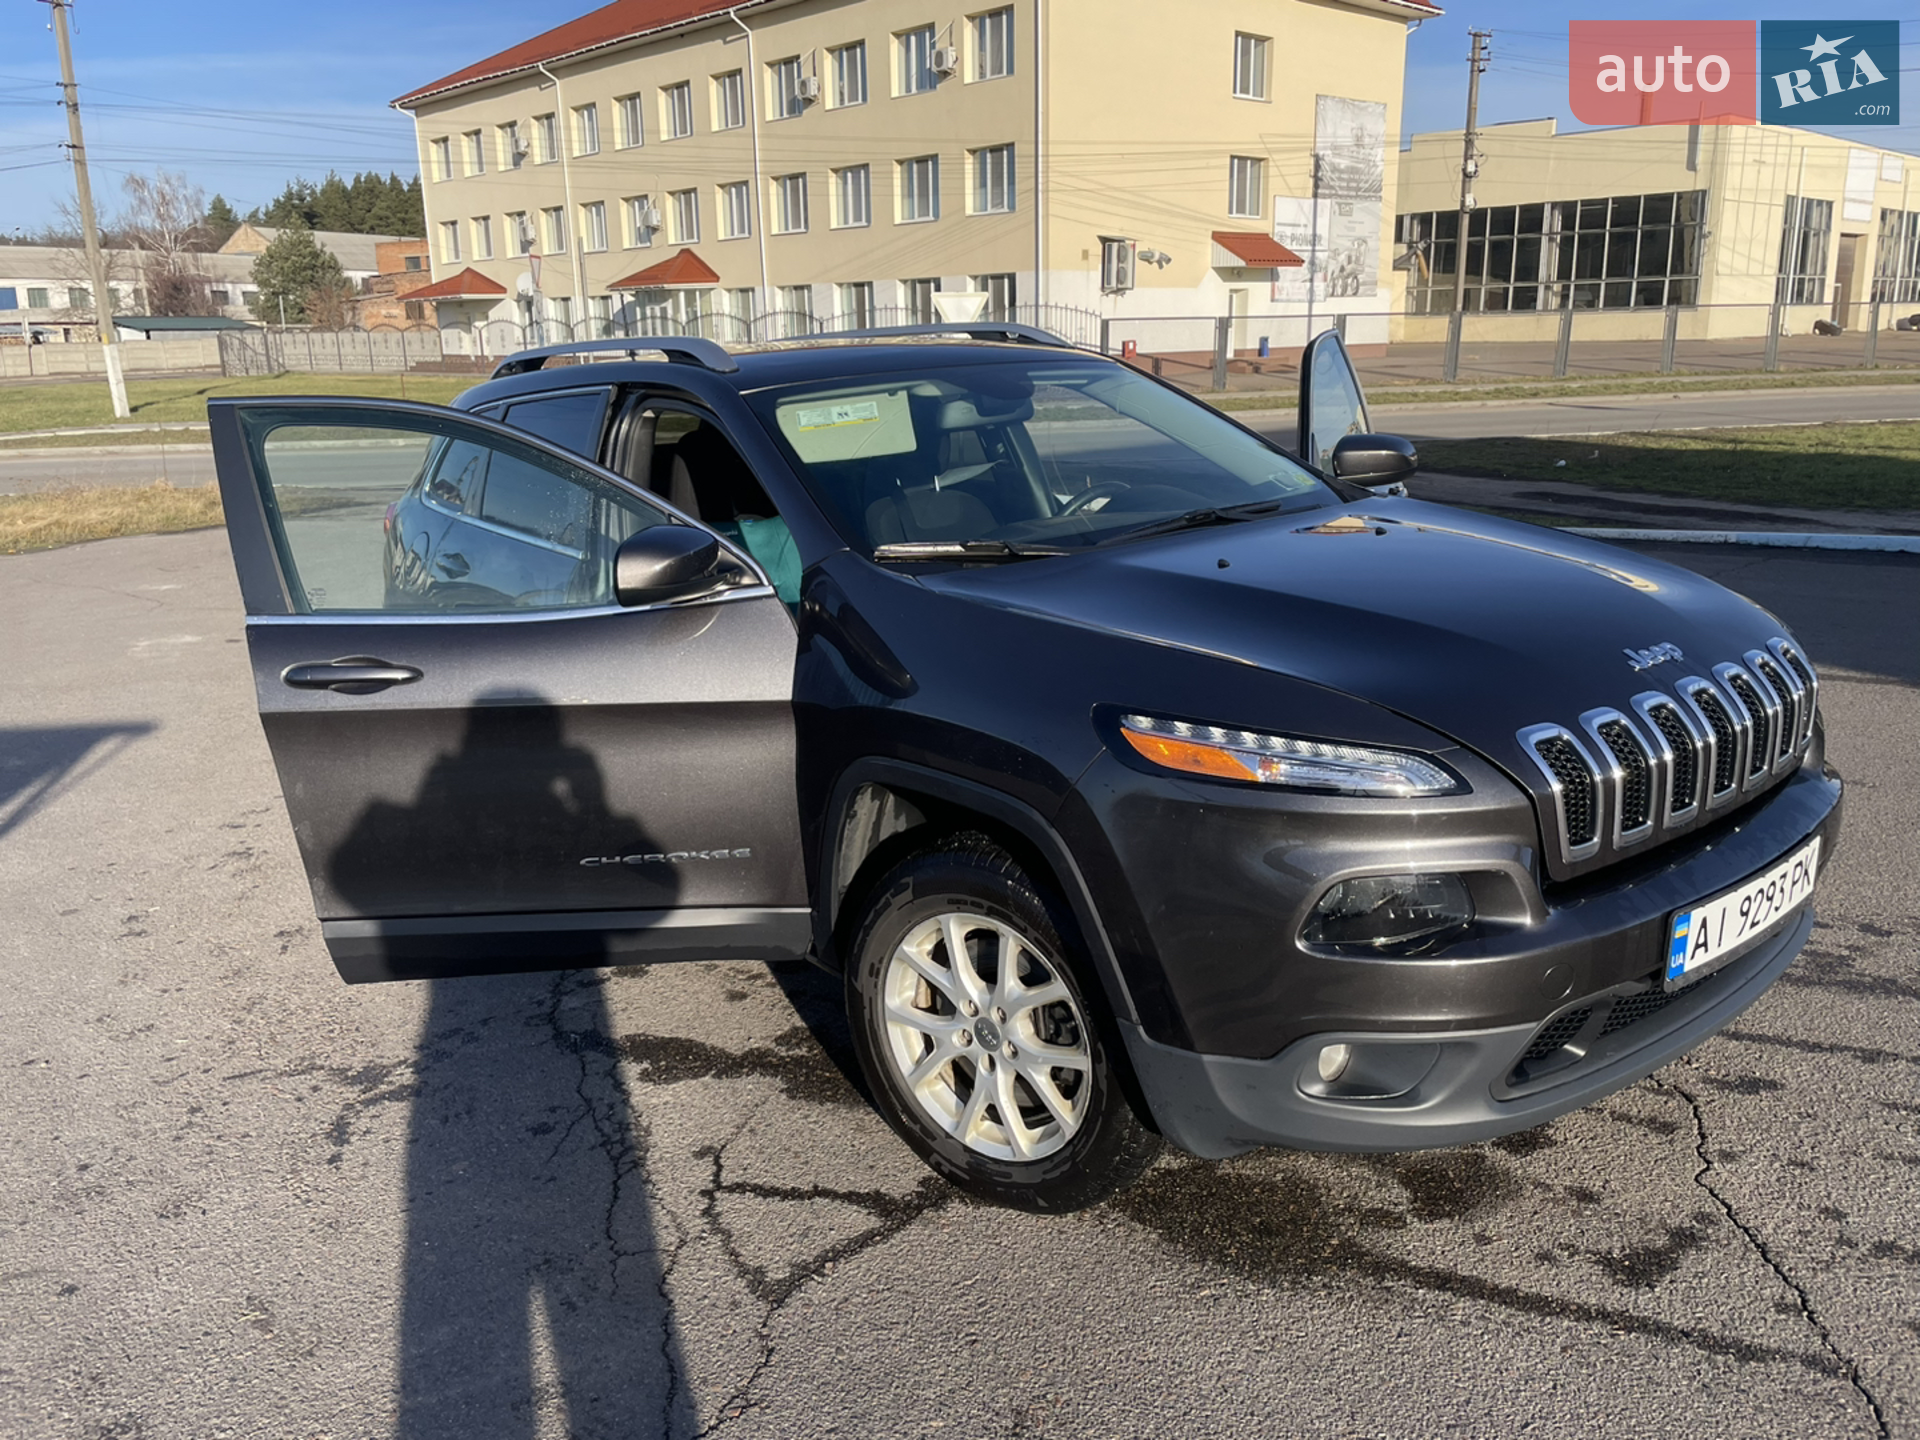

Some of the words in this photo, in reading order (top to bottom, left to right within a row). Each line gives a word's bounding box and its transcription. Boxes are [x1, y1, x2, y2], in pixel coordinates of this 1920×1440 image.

[1622, 642, 1684, 672] Jeep
[579, 848, 751, 867] CHEROKEE
[1736, 871, 1788, 938] 9293
[1671, 951, 1684, 968] UA
